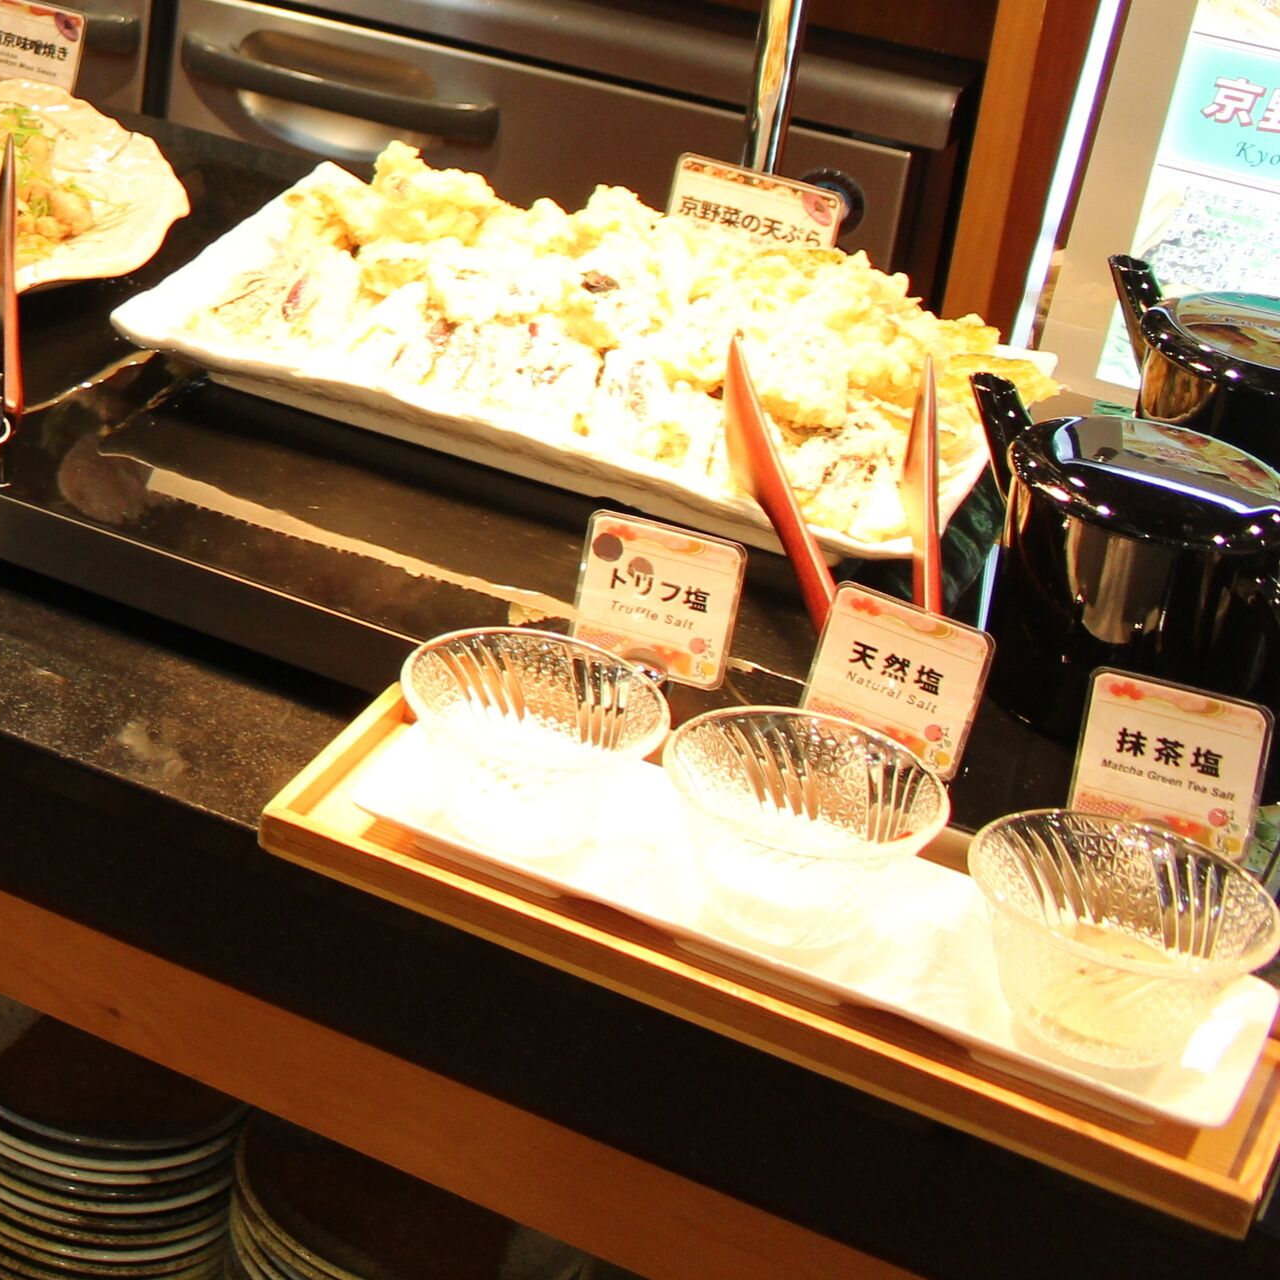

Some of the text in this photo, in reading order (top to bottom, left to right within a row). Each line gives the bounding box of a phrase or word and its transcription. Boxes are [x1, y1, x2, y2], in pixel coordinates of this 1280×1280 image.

[679, 195, 821, 247] 京野菜の天ぷら
[609, 568, 711, 613] トリフ塩
[611, 600, 694, 631] Truffle Salt
[848, 640, 944, 696] 天然塩
[845, 671, 938, 714] Natural Salt
[1115, 727, 1223, 779] 抹茶塩
[1101, 758, 1236, 802] Matcha Green Tea Salt
